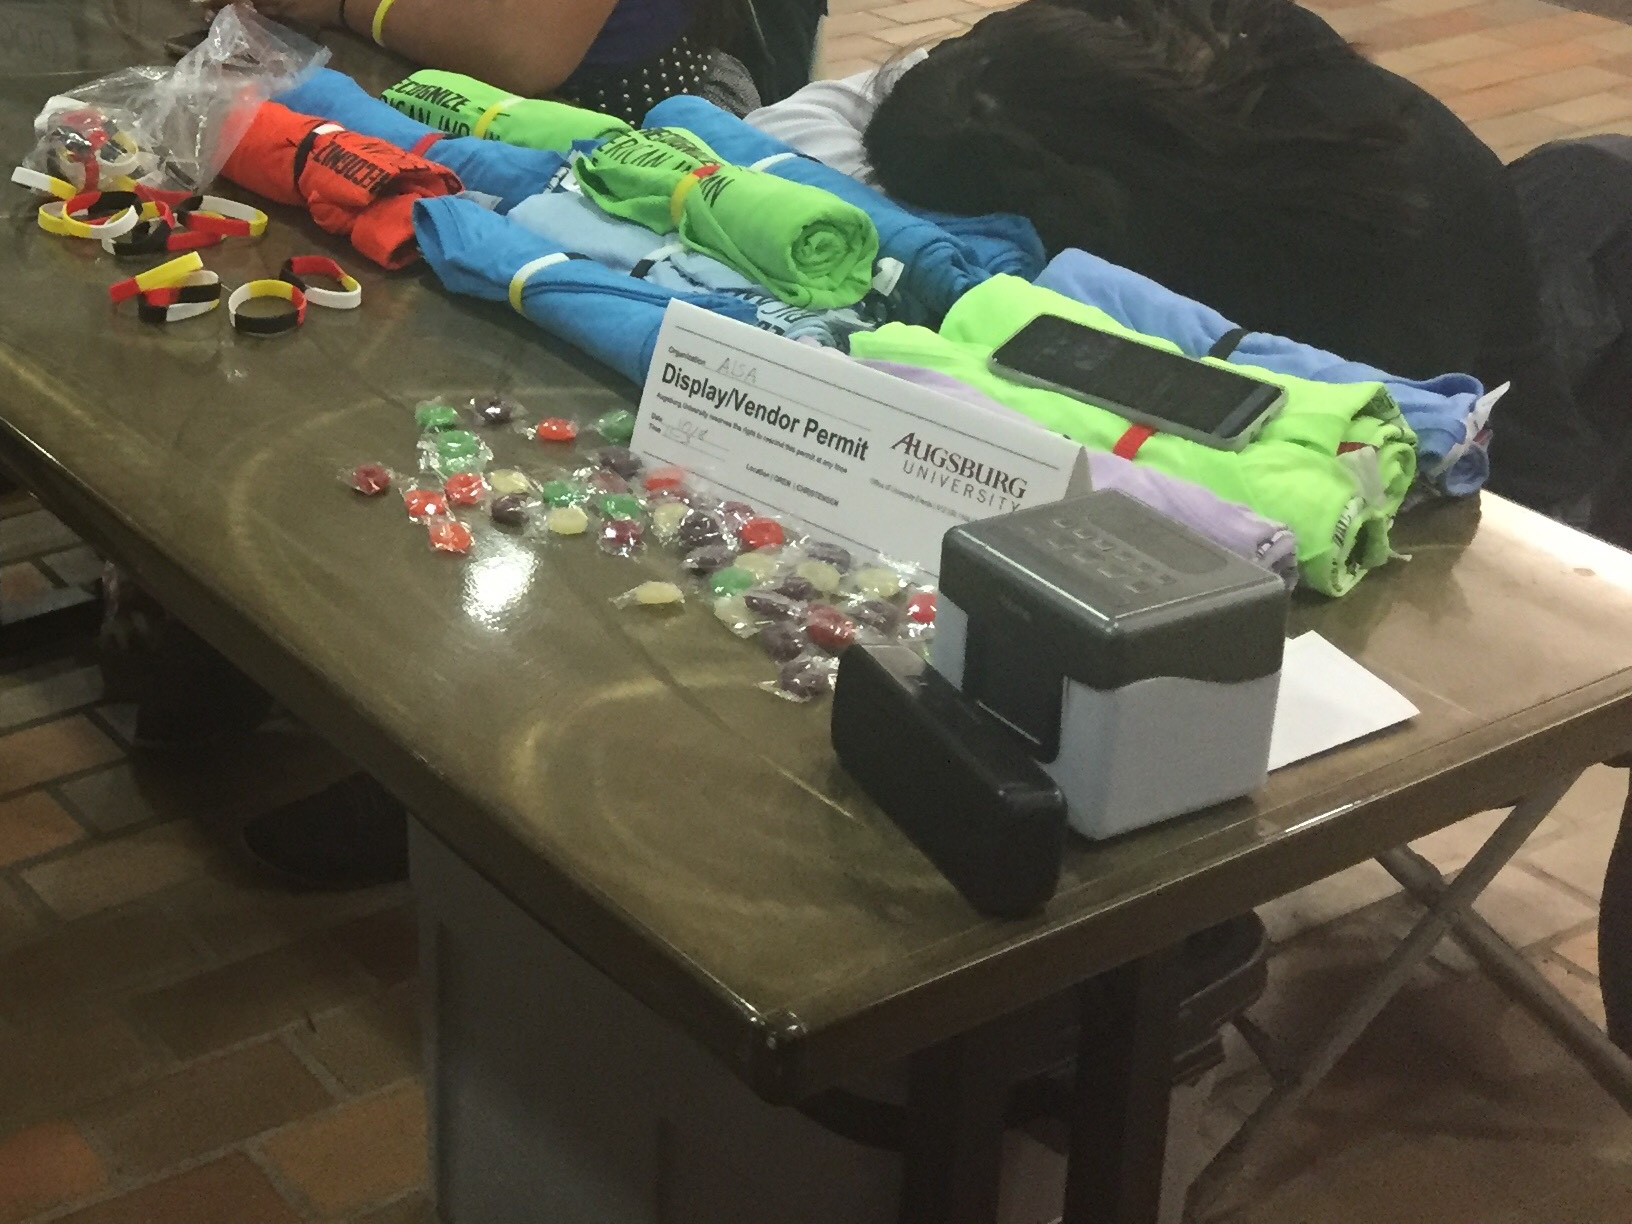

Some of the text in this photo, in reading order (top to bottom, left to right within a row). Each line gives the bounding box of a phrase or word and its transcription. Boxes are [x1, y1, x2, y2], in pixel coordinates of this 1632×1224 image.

[662, 362, 870, 461] Display/Vendor Permit
[890, 432, 1028, 499] AUGSBURG
[903, 459, 1021, 512] UNIVERSITY
